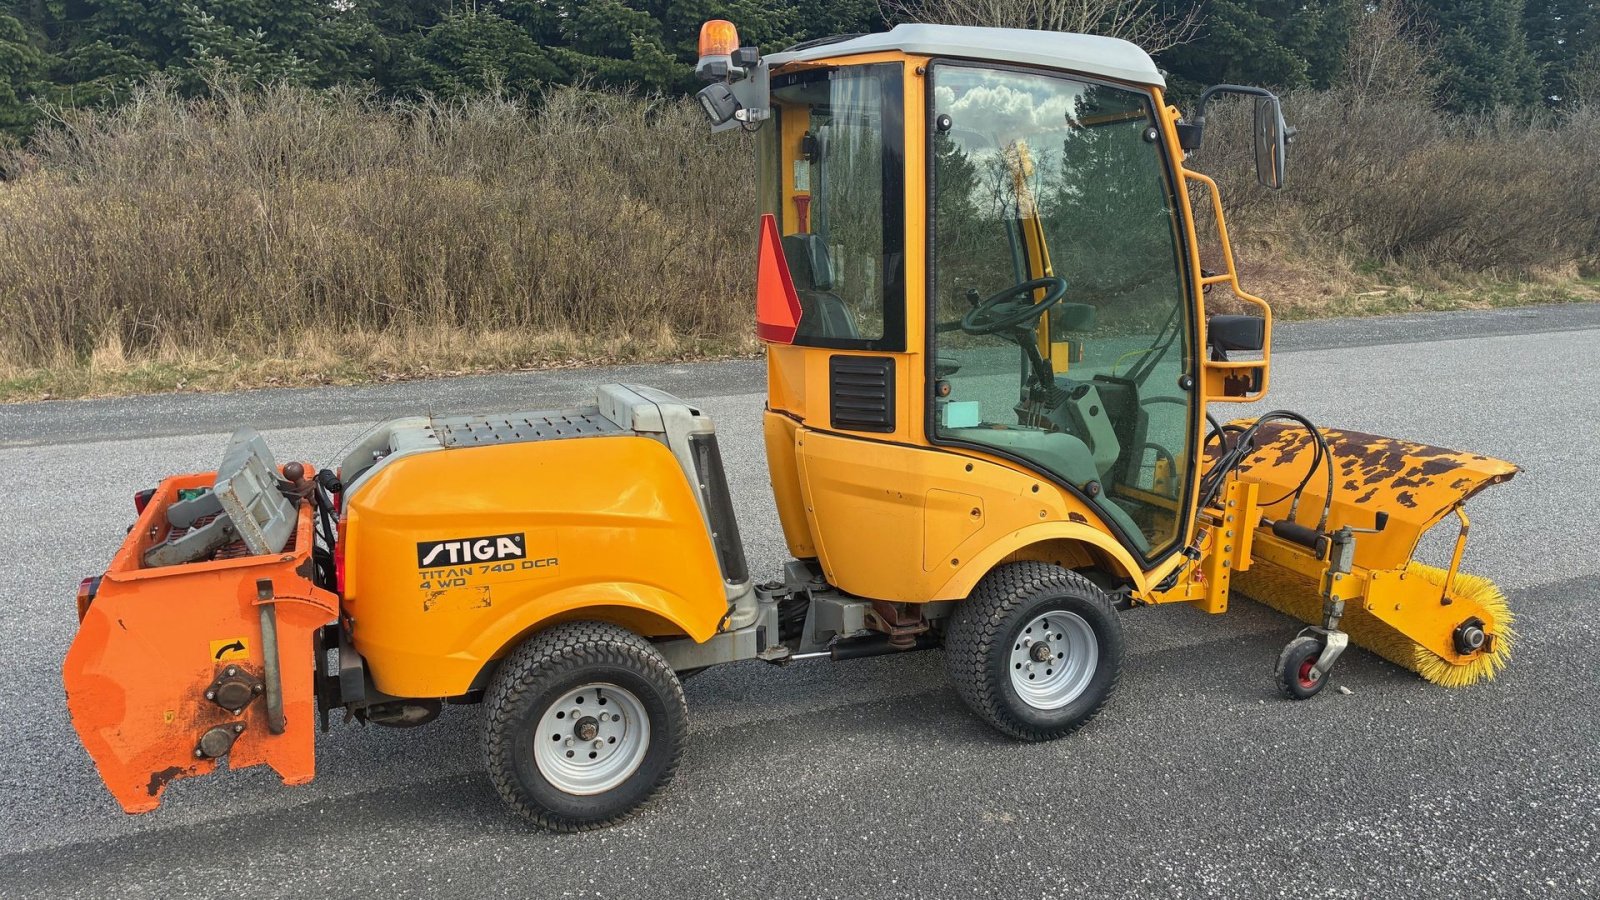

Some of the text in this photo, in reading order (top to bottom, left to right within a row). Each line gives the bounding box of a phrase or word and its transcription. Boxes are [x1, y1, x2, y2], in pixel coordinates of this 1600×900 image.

[423, 537, 522, 566] STIGA
[419, 557, 559, 580] TITAN 740 DCR
[420, 578, 466, 589] 4 WD
